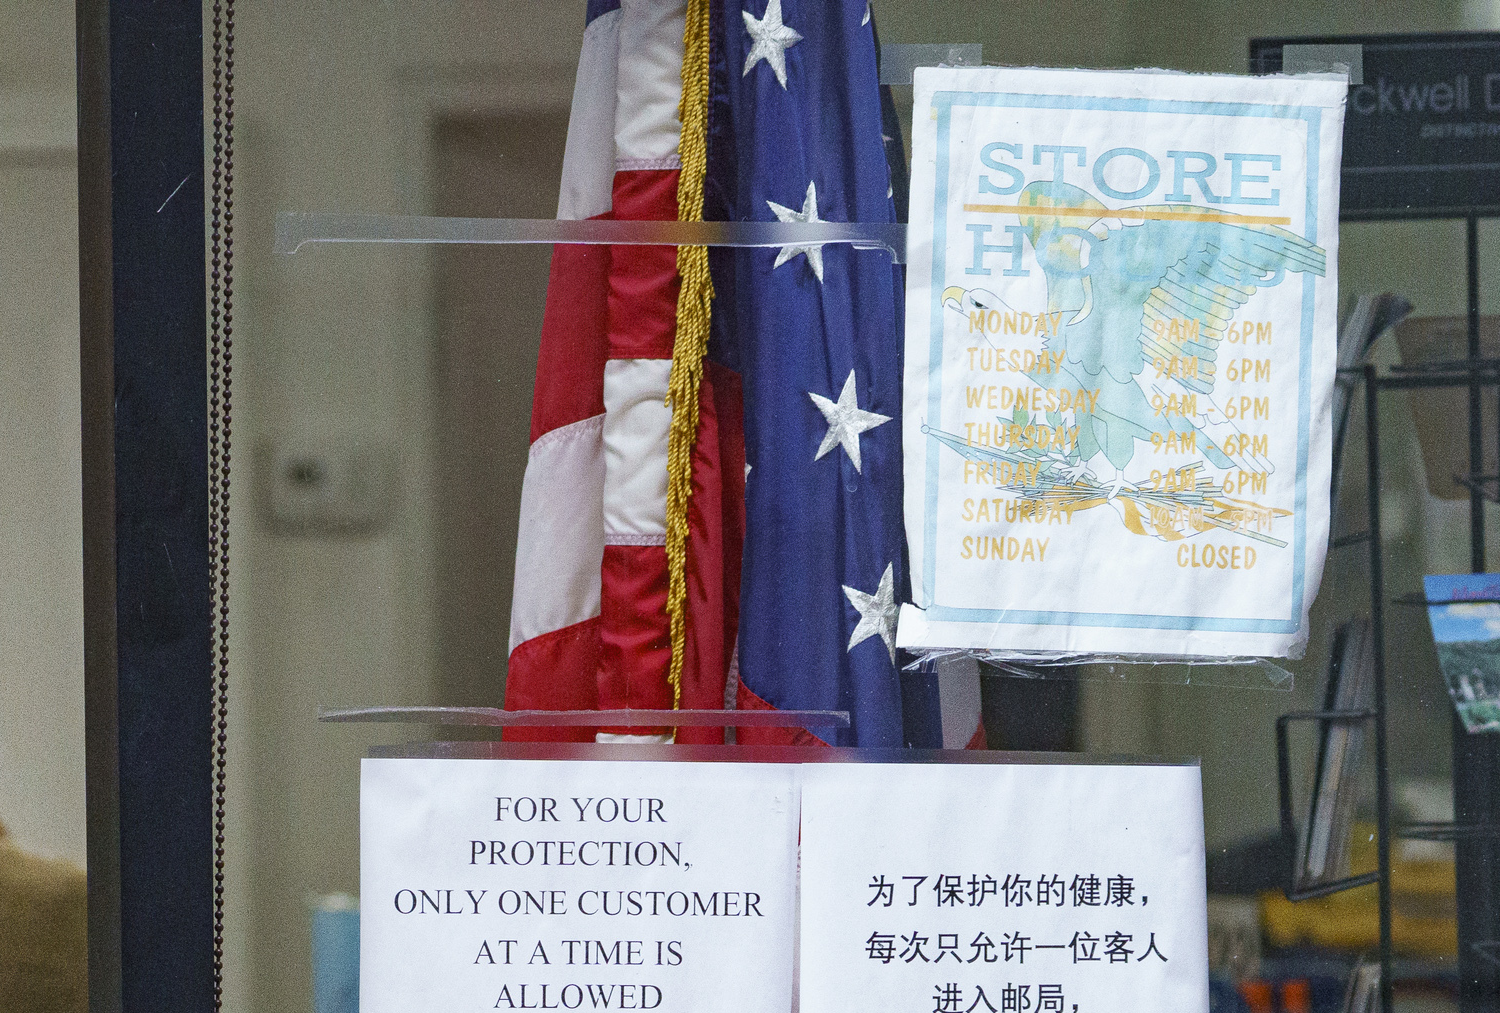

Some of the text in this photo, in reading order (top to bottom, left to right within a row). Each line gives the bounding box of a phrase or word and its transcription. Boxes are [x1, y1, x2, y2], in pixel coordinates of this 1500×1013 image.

[1351, 74, 1470, 115] ckwell
[977, 141, 1282, 206] STORE
[969, 310, 1062, 337] MONDAY
[1153, 318, 1200, 343] 9AM
[1227, 321, 1272, 345] 6PM
[966, 347, 1065, 374] TUESDAY
[1152, 355, 1199, 380] 9AM
[1226, 358, 1271, 383] 6PM
[966, 386, 1100, 413] WEDNESDAY
[1151, 393, 1197, 418] 9AM
[1225, 396, 1269, 421] 6PM
[964, 423, 1081, 451] THURSDAY
[1150, 430, 1196, 455] 9AM
[1223, 433, 1268, 458] 6PM
[963, 461, 1042, 486] FRIDAY
[1149, 468, 1196, 493] 9AM
[1222, 471, 1267, 495] 6PM
[961, 498, 1272, 533] SATURDAY 10AM 5PM
[960, 536, 1257, 570] SUNDAY CLOSED
[494, 796, 668, 824] FOR YOUR
[468, 840, 692, 872] PROTECTION,
[394, 888, 765, 917] ONLY ONE CUSTOMER
[866, 873, 1150, 909] 为了保护你的健康，
[473, 939, 683, 967] AT A TIME IS
[864, 931, 1169, 965] 每次只允许一位客人
[493, 983, 663, 1010] ALLOWED
